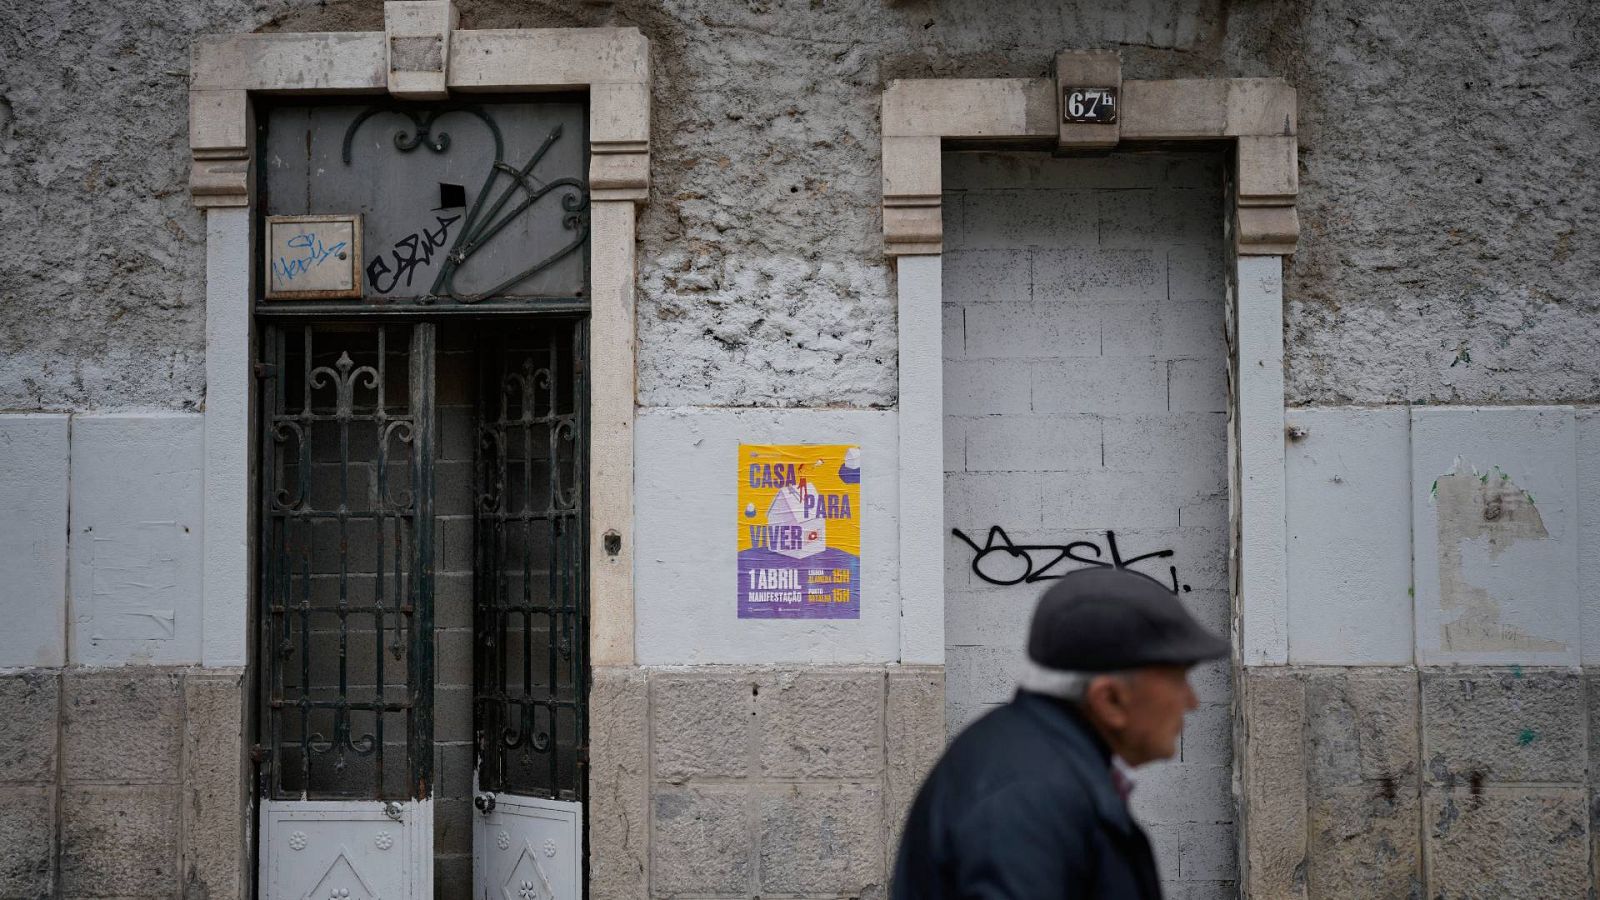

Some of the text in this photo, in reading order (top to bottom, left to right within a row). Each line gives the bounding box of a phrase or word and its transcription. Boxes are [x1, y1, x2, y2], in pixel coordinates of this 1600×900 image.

[749, 463, 797, 489] CASA
[804, 494, 852, 519] PARA
[749, 525, 803, 551] VIVER
[748, 568, 802, 590] 1 ABRIL
[748, 591, 802, 604] MANIFESTAÇÃO
